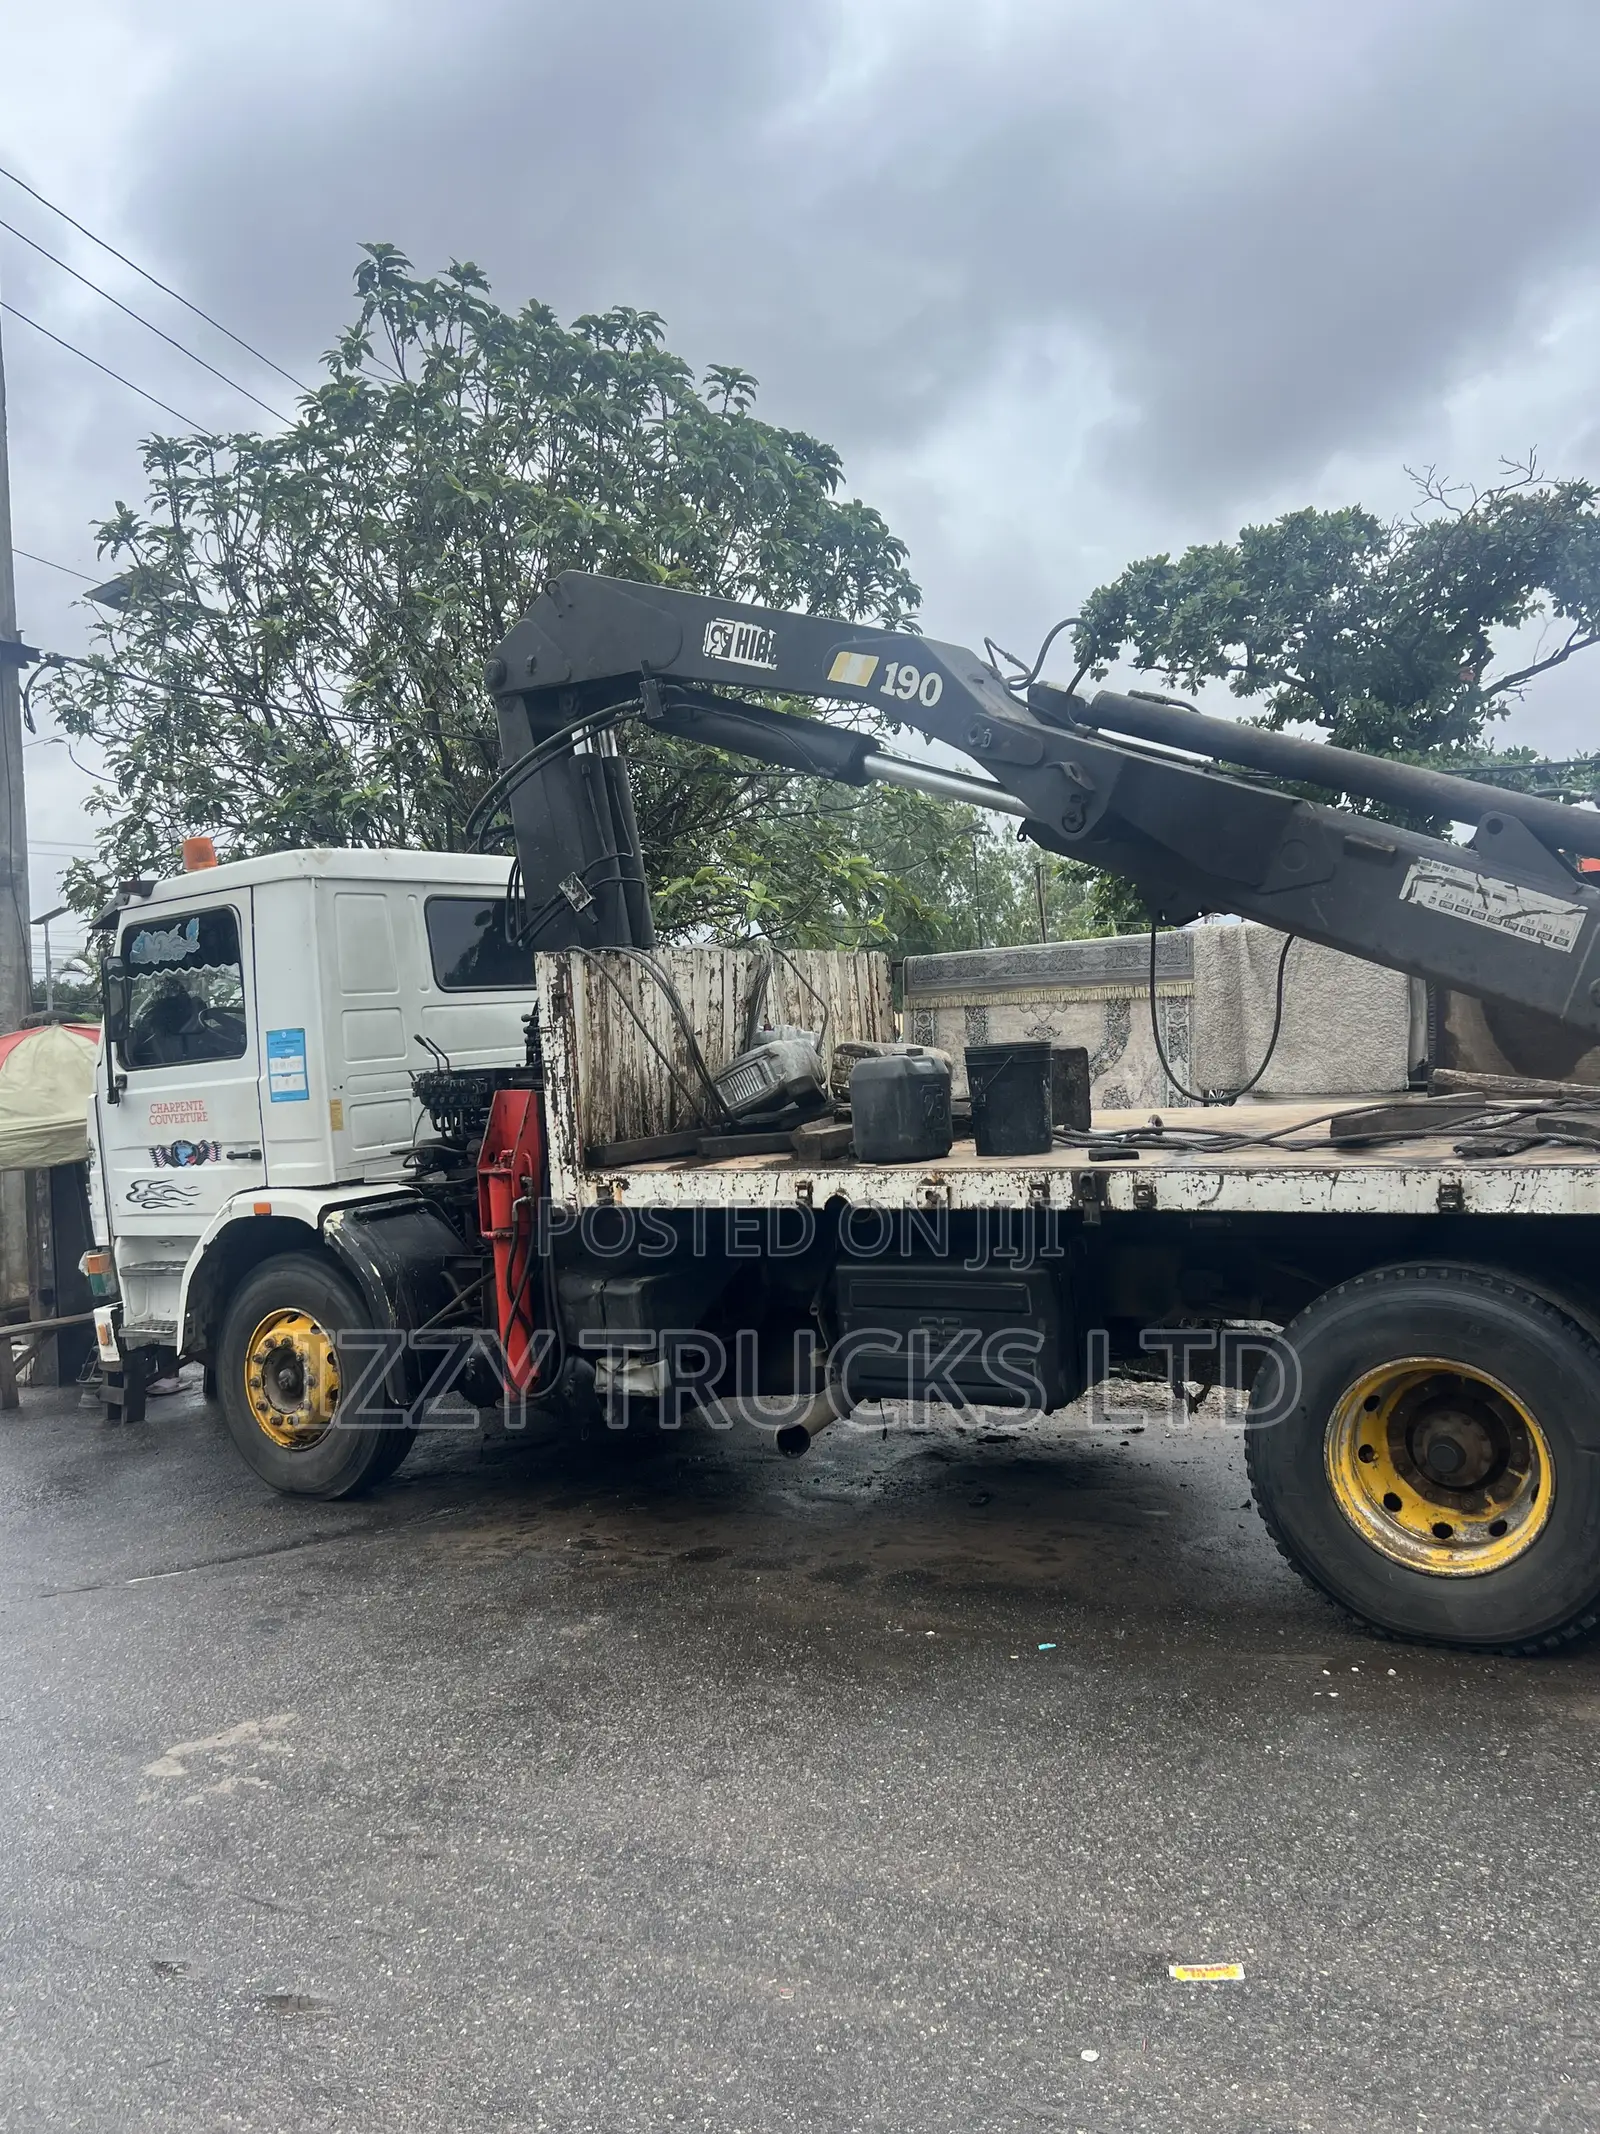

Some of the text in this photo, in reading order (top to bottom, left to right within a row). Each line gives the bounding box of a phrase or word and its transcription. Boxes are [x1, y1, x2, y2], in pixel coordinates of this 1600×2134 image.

[880, 661, 943, 707] 190
[150, 1100, 204, 1114] CHARPENTE
[149, 1112, 208, 1125] COUVERTURE
